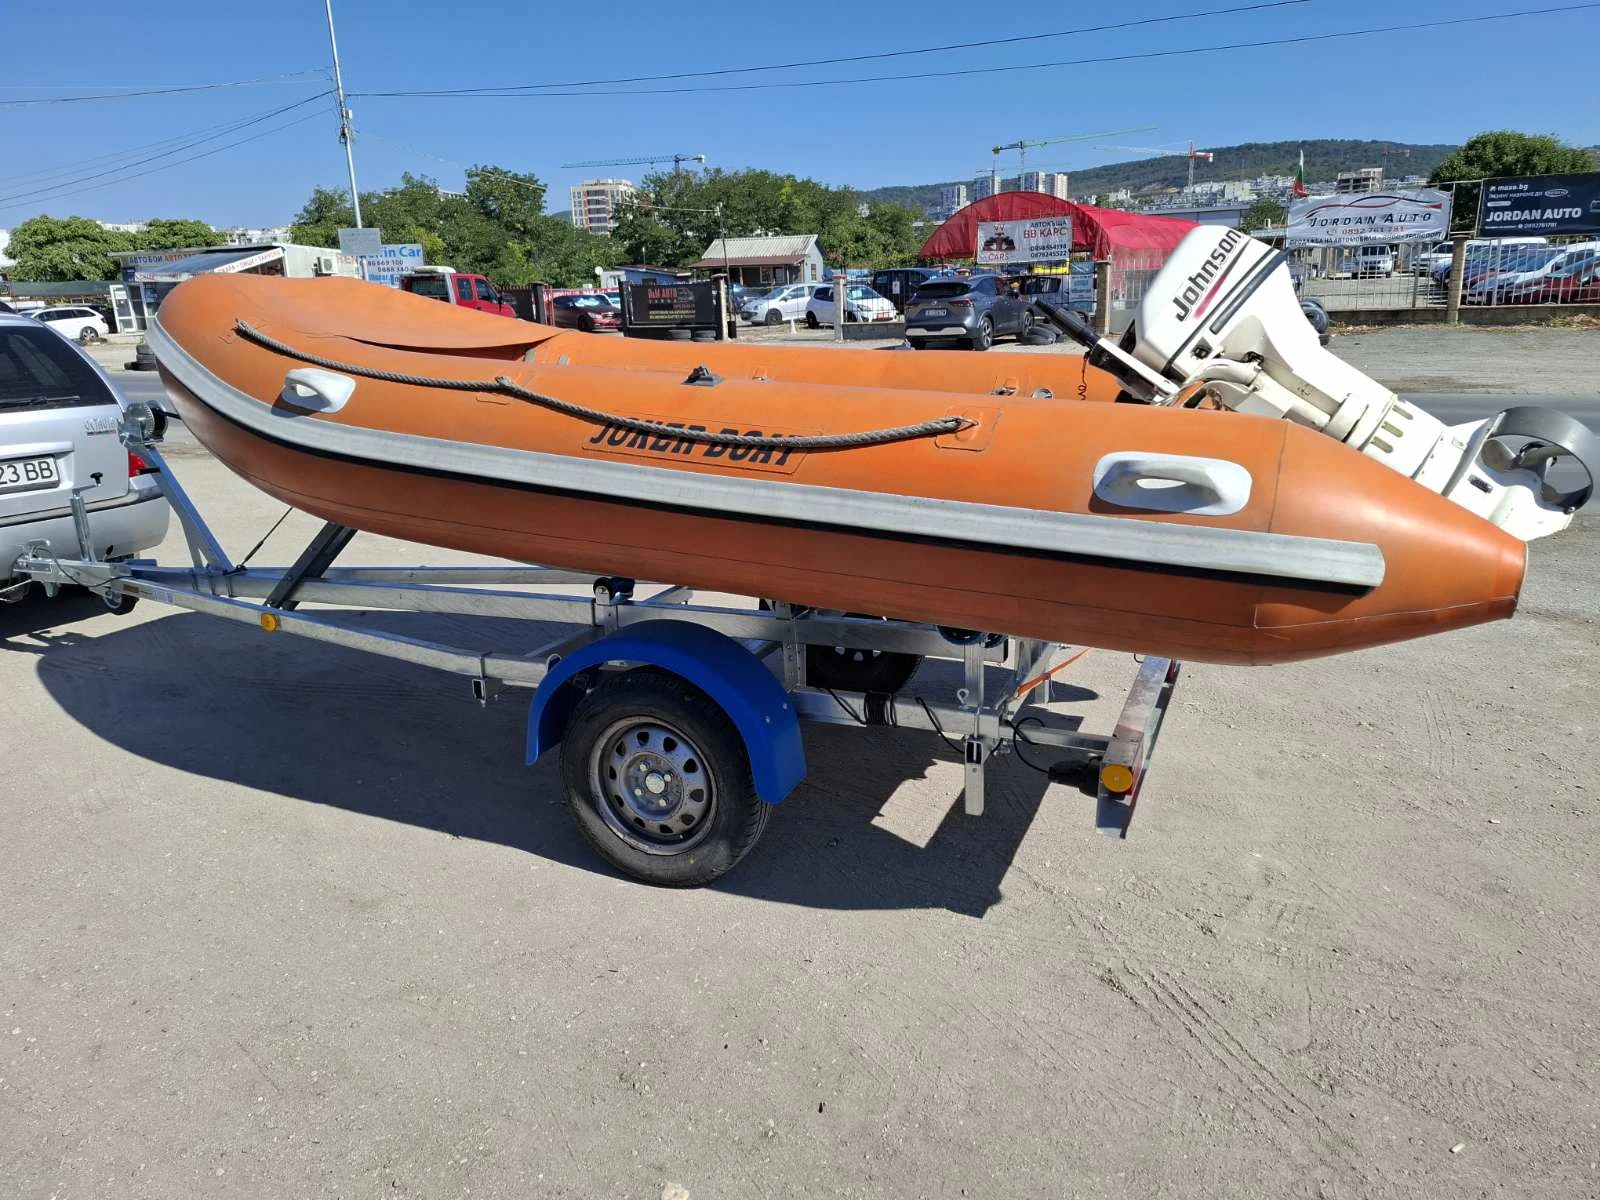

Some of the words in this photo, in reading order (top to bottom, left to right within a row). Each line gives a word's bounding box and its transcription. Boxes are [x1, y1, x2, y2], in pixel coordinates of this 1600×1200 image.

[1308, 217, 1376, 228] JORDAN
[1384, 213, 1431, 224] AUTO
[1486, 210, 1541, 222] JORDAN
[1542, 207, 1582, 219] AUTO
[1039, 227, 1067, 238] КАРС
[399, 246, 422, 258] Car
[1172, 229, 1242, 322] Johnson
[23, 460, 54, 482] BB
